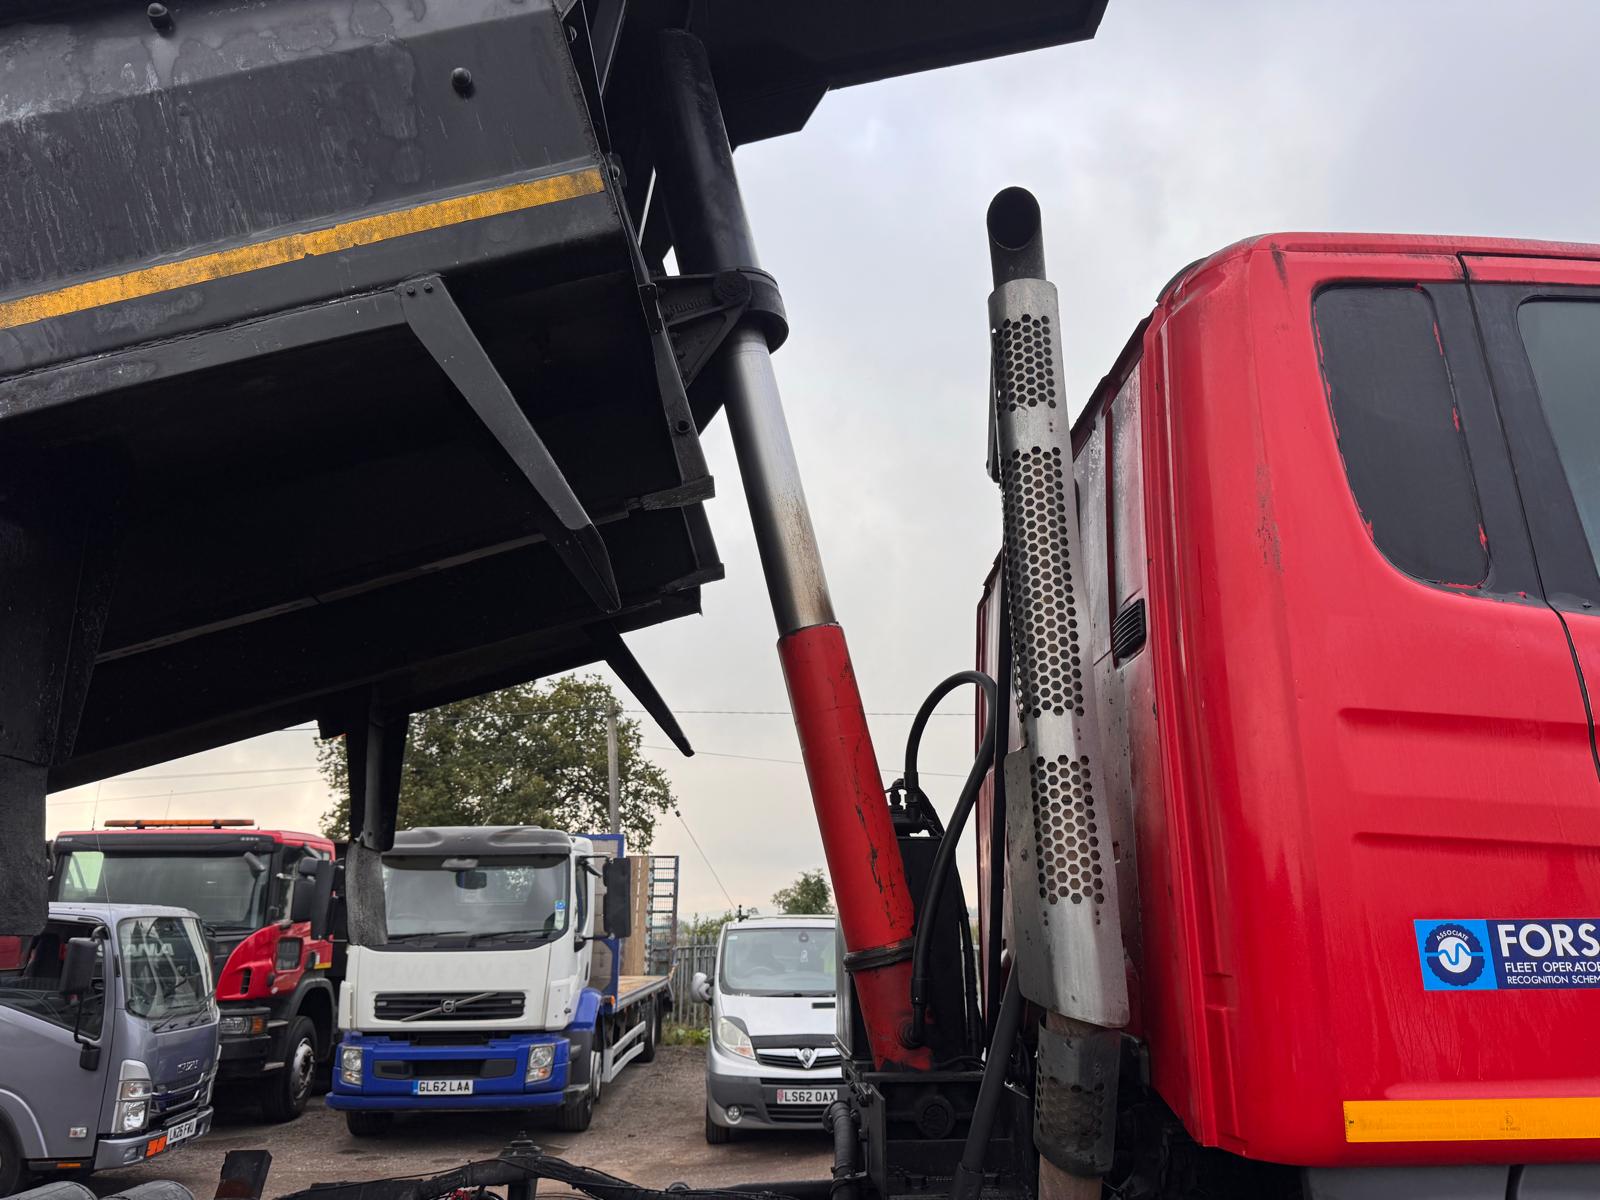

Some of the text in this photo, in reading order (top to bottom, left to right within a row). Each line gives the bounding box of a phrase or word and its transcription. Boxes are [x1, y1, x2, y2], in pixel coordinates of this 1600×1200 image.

[1436, 930, 1469, 941] ASSOCIATE
[1497, 923, 1600, 957] FORS
[1505, 961, 1538, 973] FLEET
[1507, 975, 1569, 984] RECOGNITION
[419, 1081, 470, 1092] GL62 LAA
[784, 1091, 836, 1102] LS62 OAX
